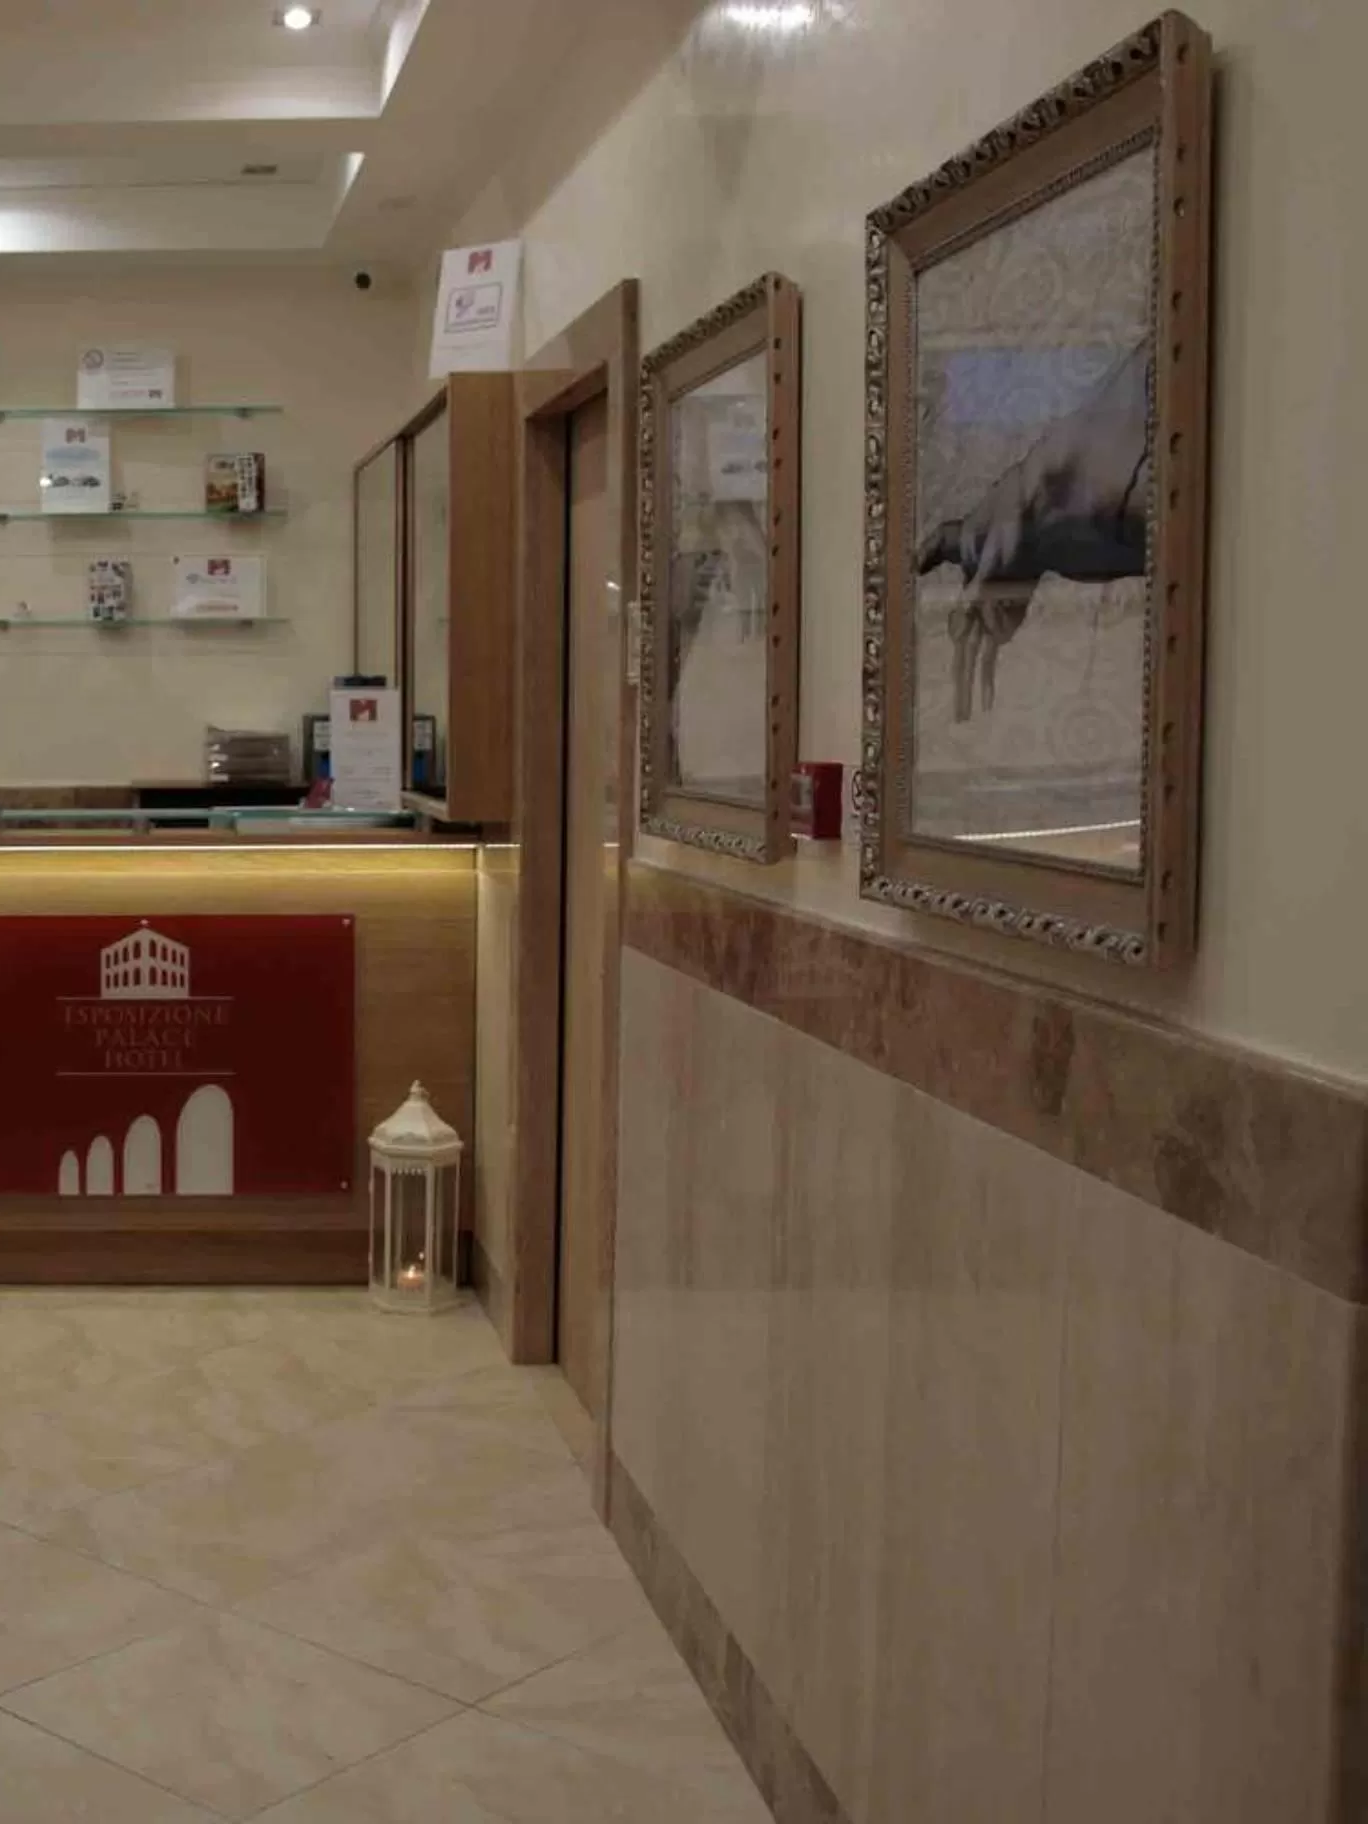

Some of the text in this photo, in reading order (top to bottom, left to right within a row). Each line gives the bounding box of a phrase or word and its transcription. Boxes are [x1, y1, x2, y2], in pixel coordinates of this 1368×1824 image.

[64, 1004, 229, 1027] ESPOSIZIONE
[94, 1027, 196, 1048] PALACE
[104, 1048, 186, 1069] HOTEL
